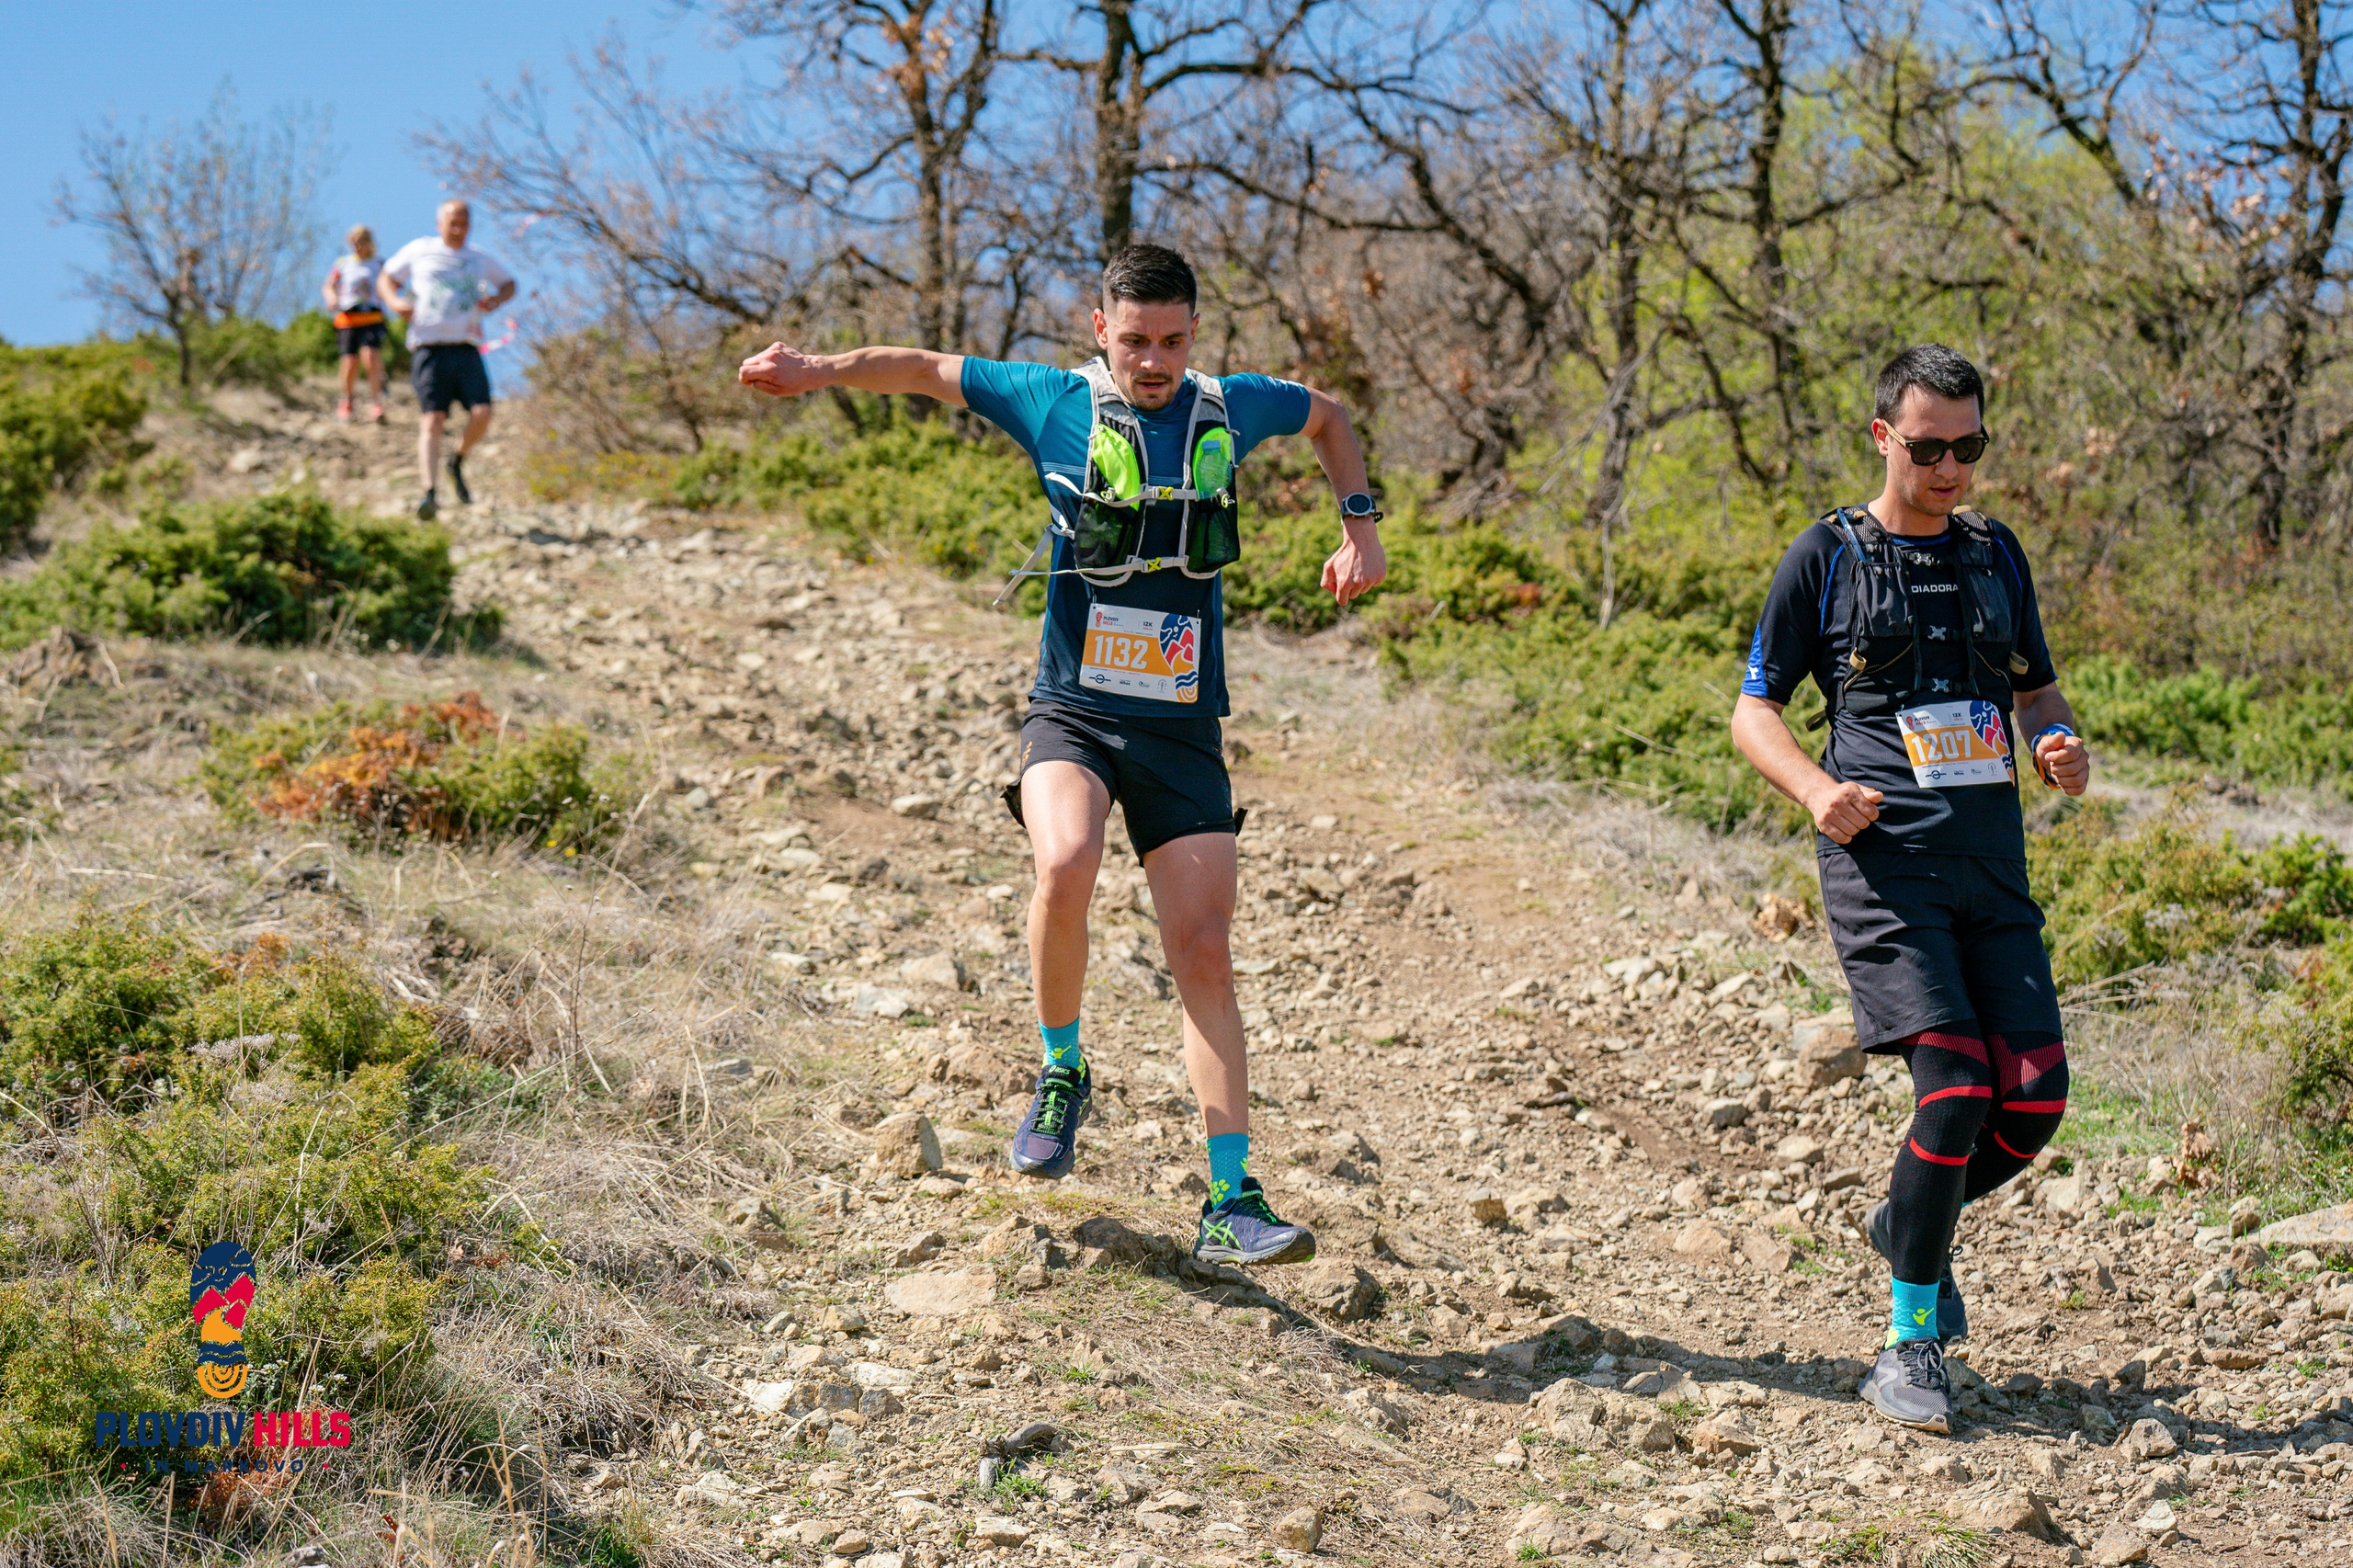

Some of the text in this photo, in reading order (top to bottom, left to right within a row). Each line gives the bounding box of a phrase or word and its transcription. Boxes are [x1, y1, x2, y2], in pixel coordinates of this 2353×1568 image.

[1911, 584, 1958, 593] DIADORA
[1094, 634, 1148, 670] 1132
[1911, 730, 1971, 762] 1207
